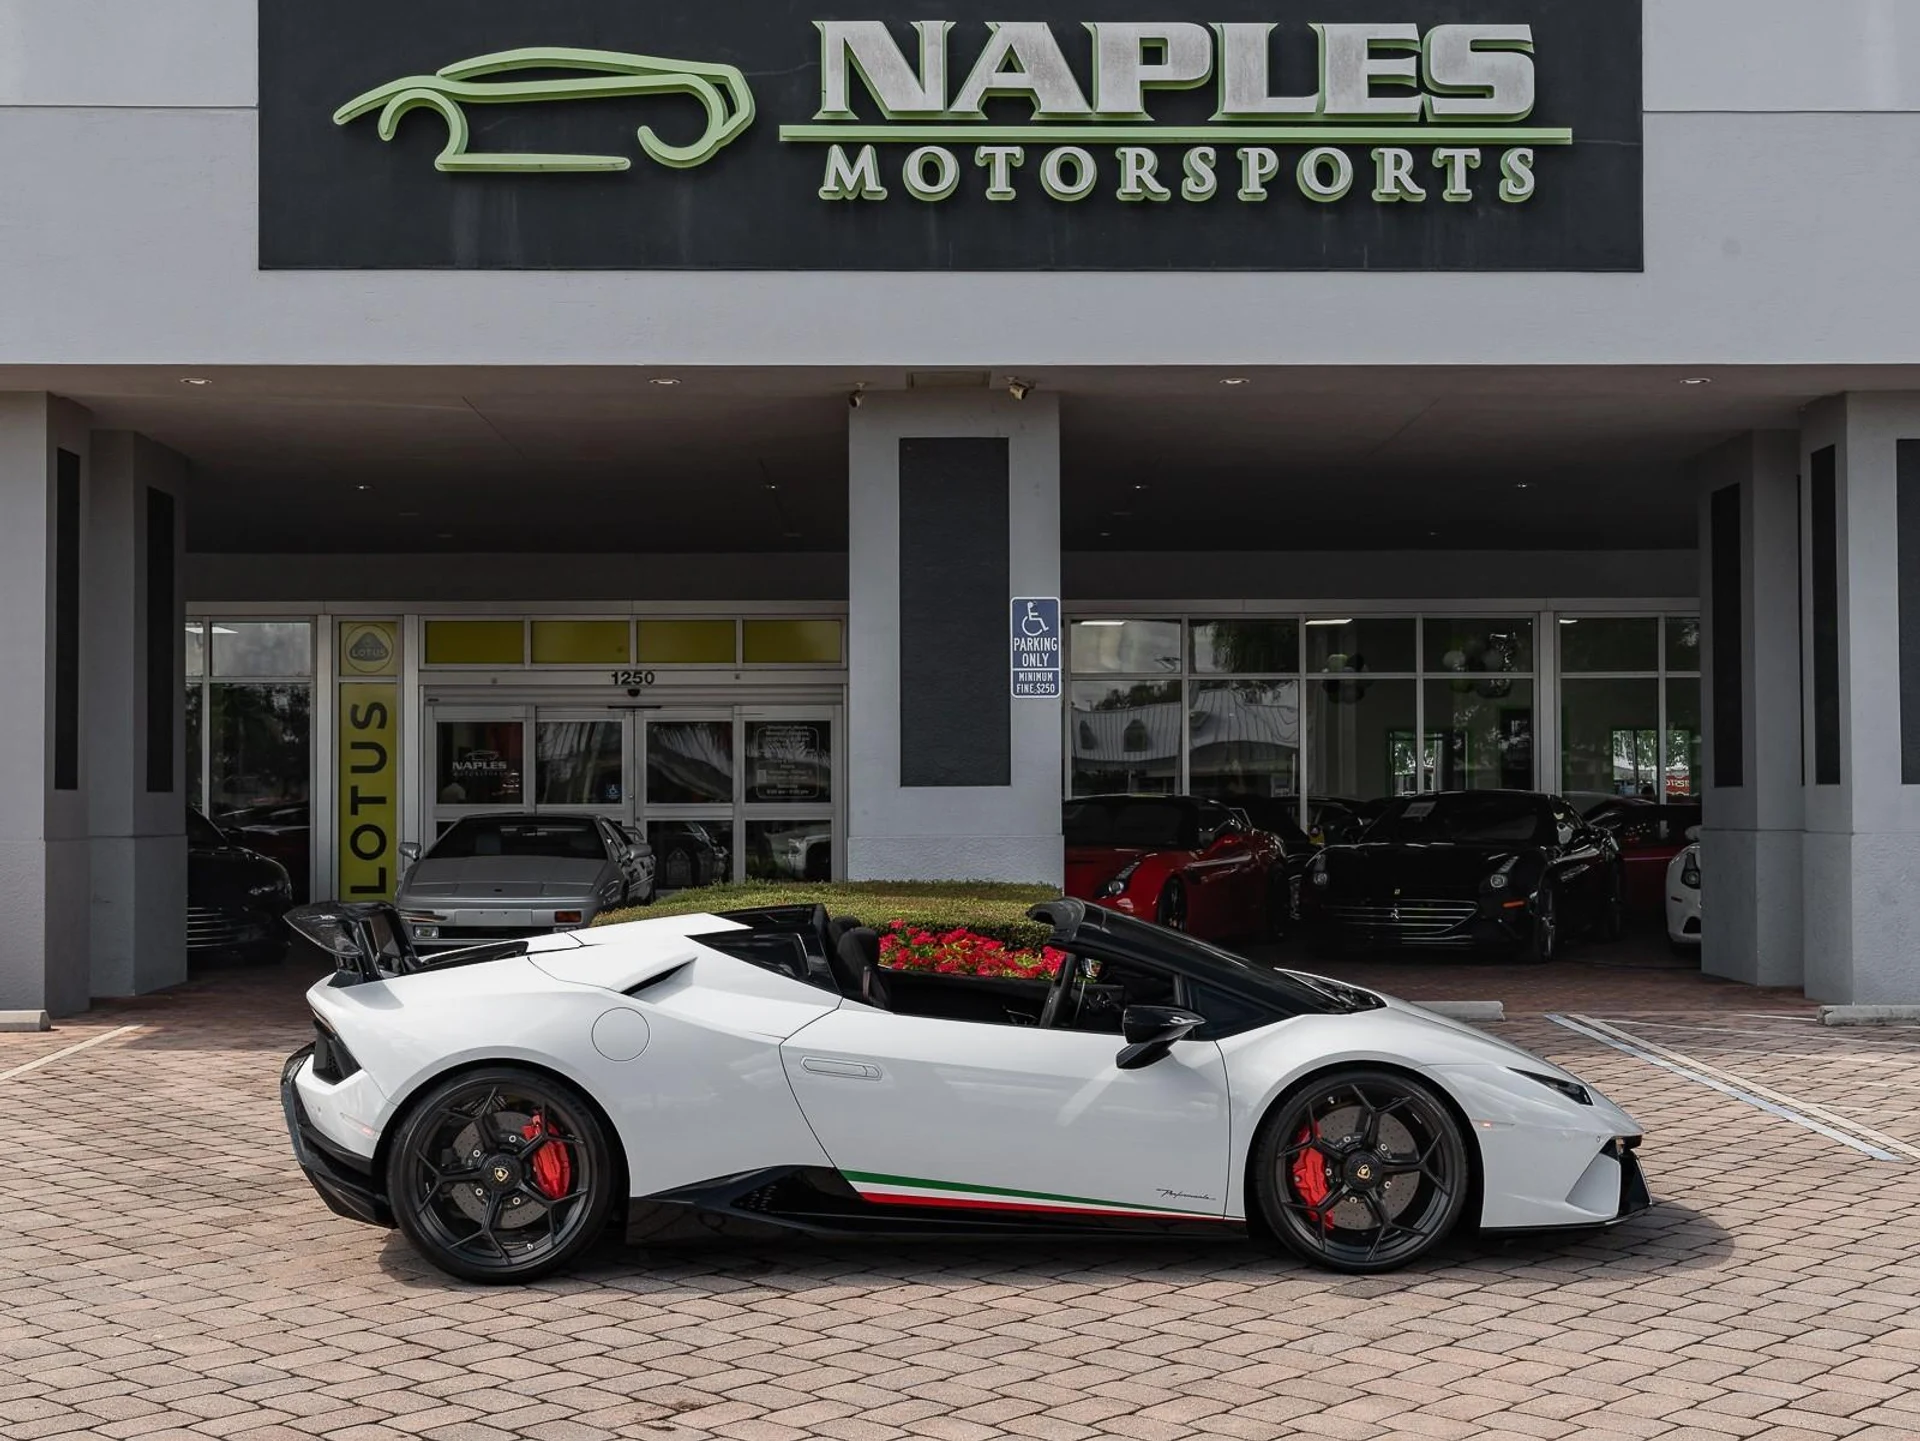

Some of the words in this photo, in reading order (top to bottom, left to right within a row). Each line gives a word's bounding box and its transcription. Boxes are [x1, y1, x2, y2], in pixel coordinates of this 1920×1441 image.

[812, 20, 1536, 121] NAPLES
[818, 143, 1535, 203] MOTORSPORTS
[1013, 637, 1058, 652] PARKING
[1022, 652, 1049, 667] ONLY
[611, 670, 655, 685] 1250
[1018, 671, 1053, 682] MINIMUM
[452, 761, 507, 770] NAPLES
[350, 702, 387, 894] LOTUS
